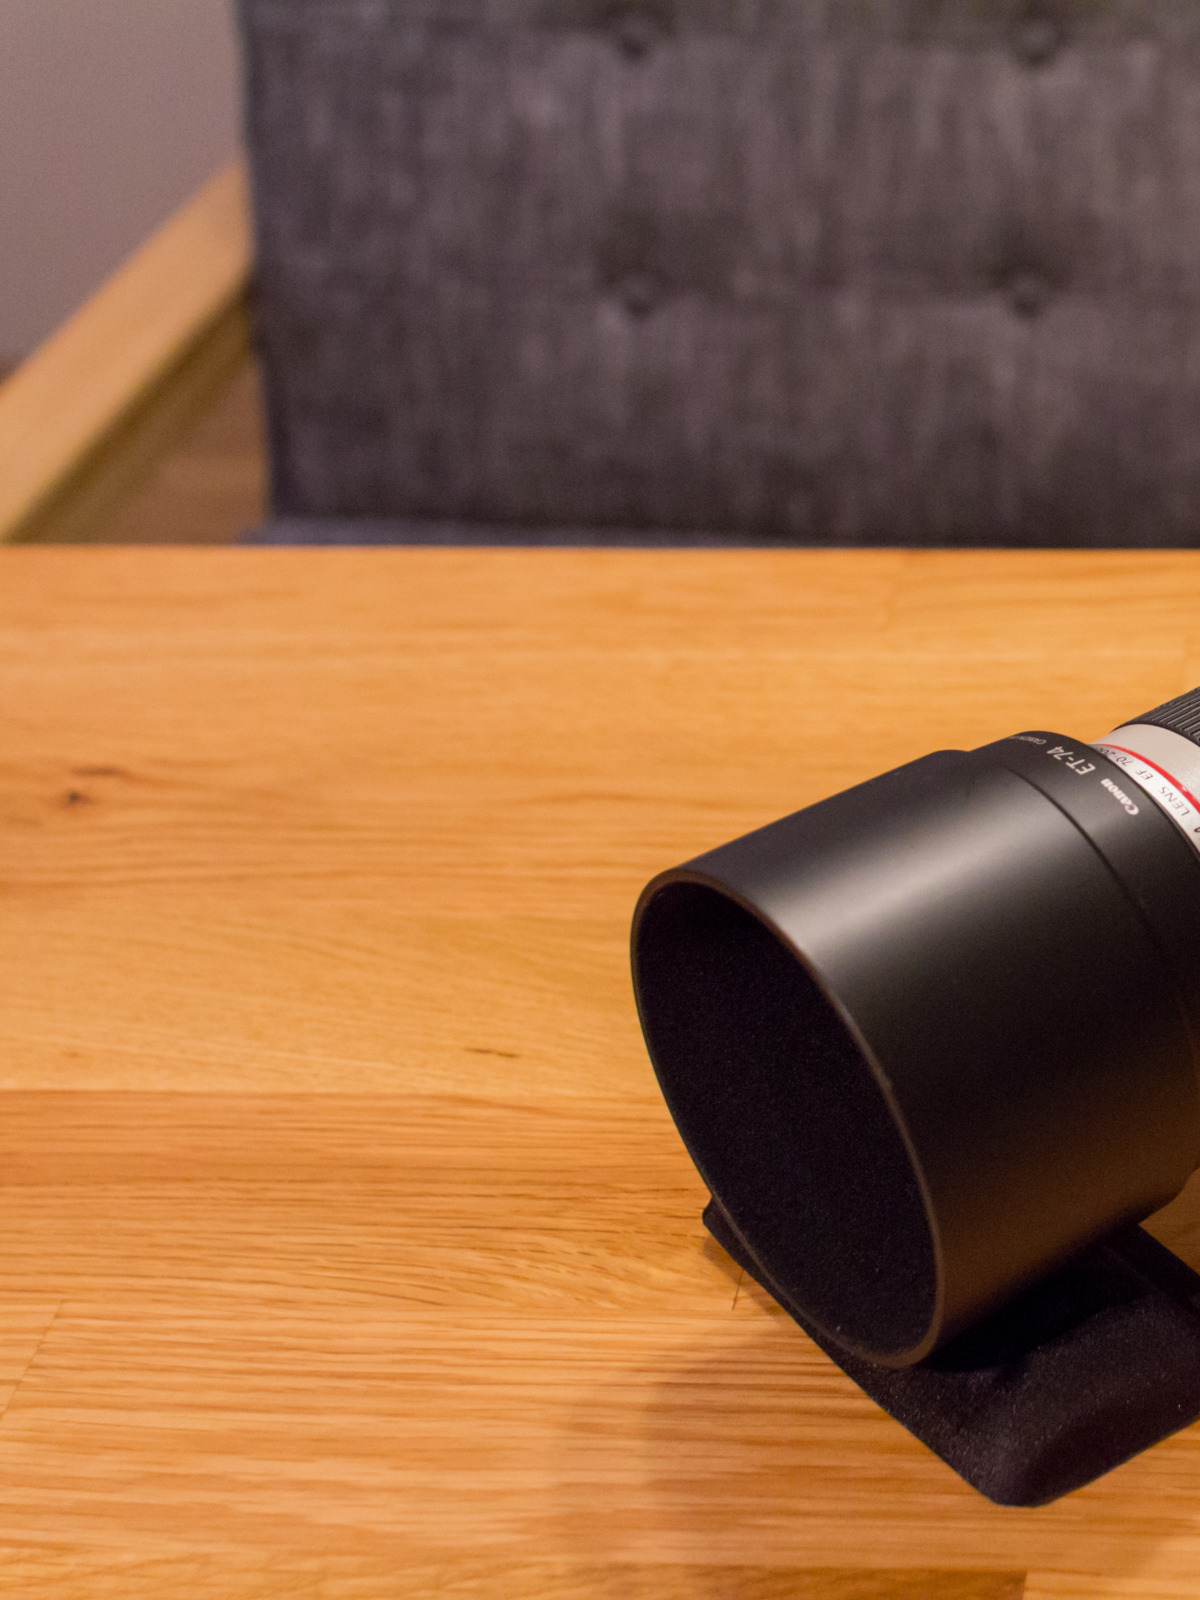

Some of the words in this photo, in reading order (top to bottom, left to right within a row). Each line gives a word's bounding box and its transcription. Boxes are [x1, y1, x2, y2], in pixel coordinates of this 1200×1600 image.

[1046, 745, 1096, 775] ET-74
[1135, 769, 1154, 781] EF
[1101, 778, 1140, 816] Canon
[1159, 786, 1190, 817] LENS
